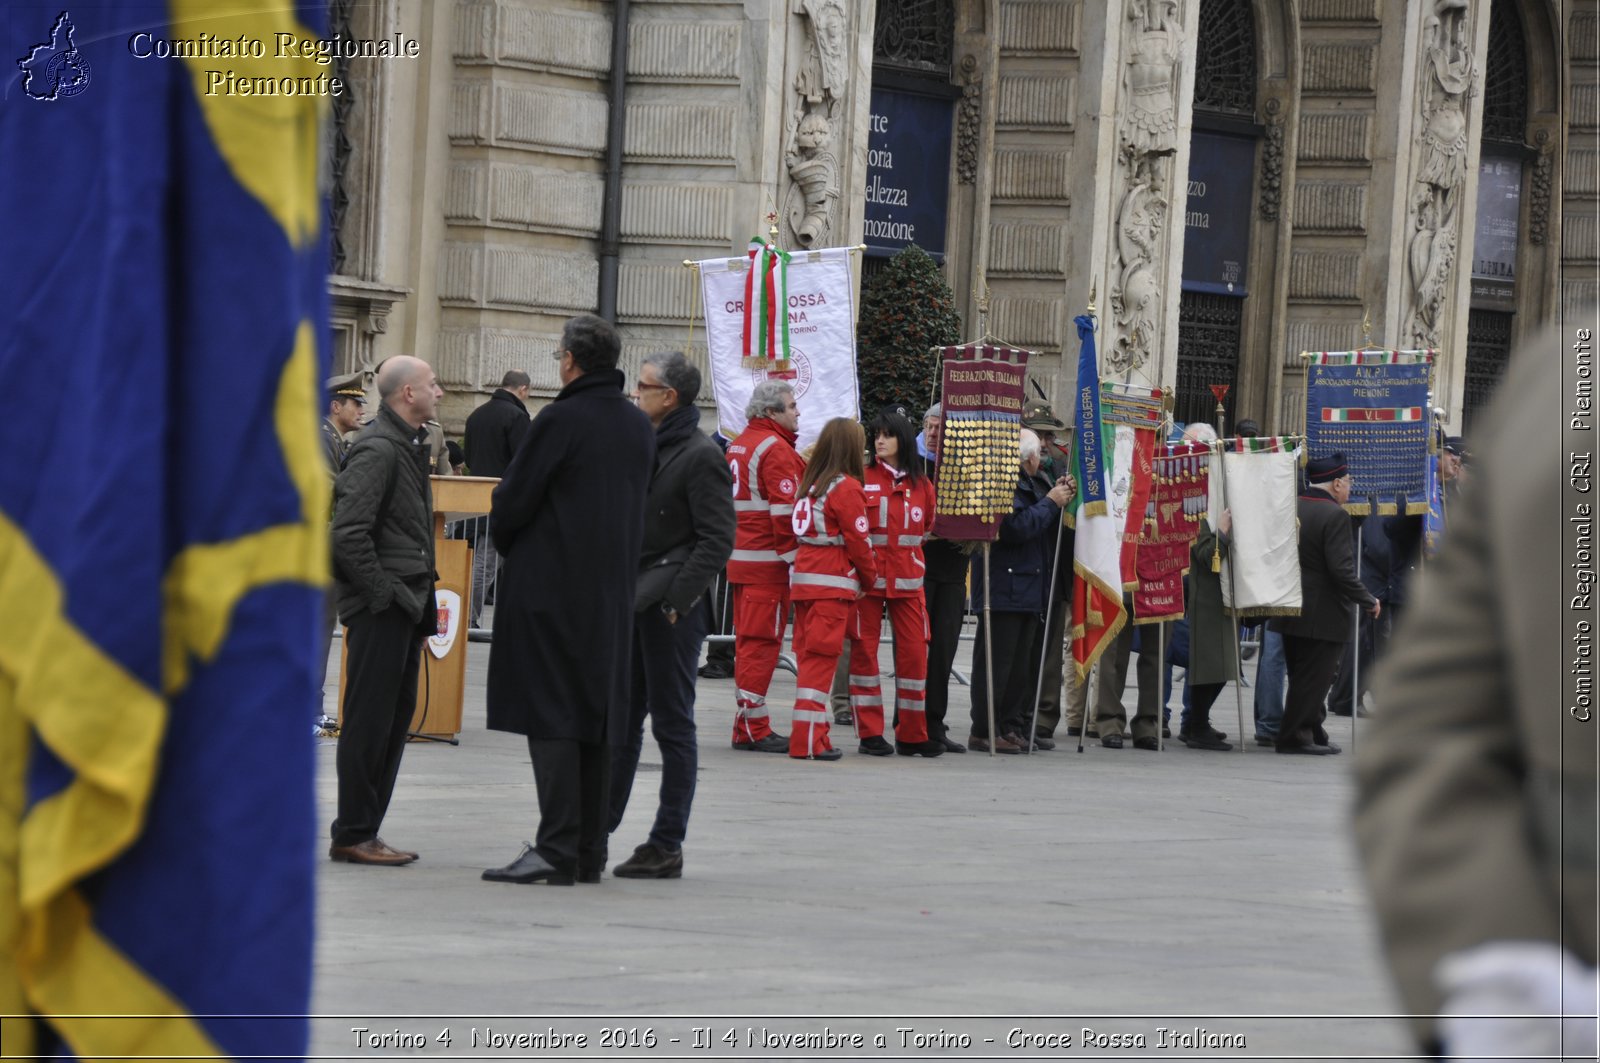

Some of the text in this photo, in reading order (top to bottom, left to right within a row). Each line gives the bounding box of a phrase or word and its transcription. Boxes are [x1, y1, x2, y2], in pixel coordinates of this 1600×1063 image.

[949, 369, 1021, 386] FEDERAZIONE ITALIANA
[1353, 388, 1390, 397] PIEMONTE
[1082, 386, 1094, 420] GUERRA
